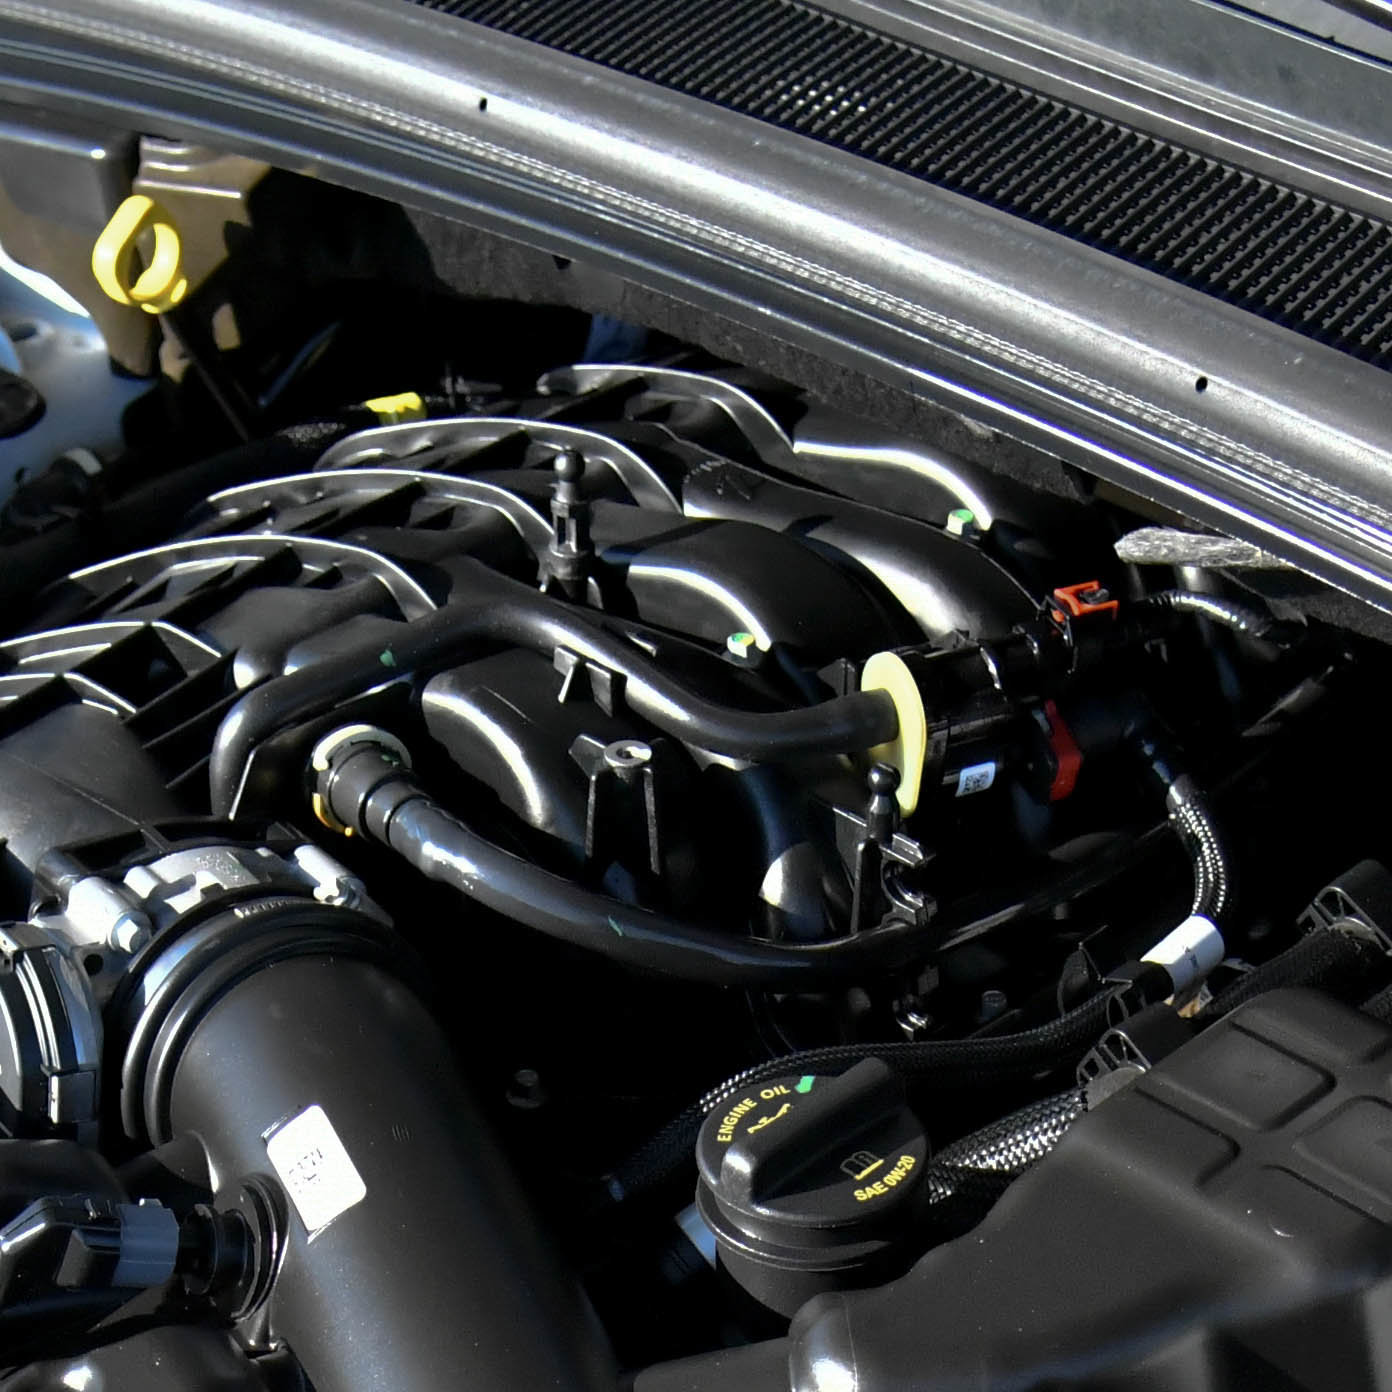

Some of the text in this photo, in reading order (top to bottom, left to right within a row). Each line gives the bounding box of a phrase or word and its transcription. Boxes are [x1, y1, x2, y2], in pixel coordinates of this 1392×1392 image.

[717, 1085, 791, 1142] ENGINE OIL
[854, 1155, 916, 1201] SAE 0W-20
